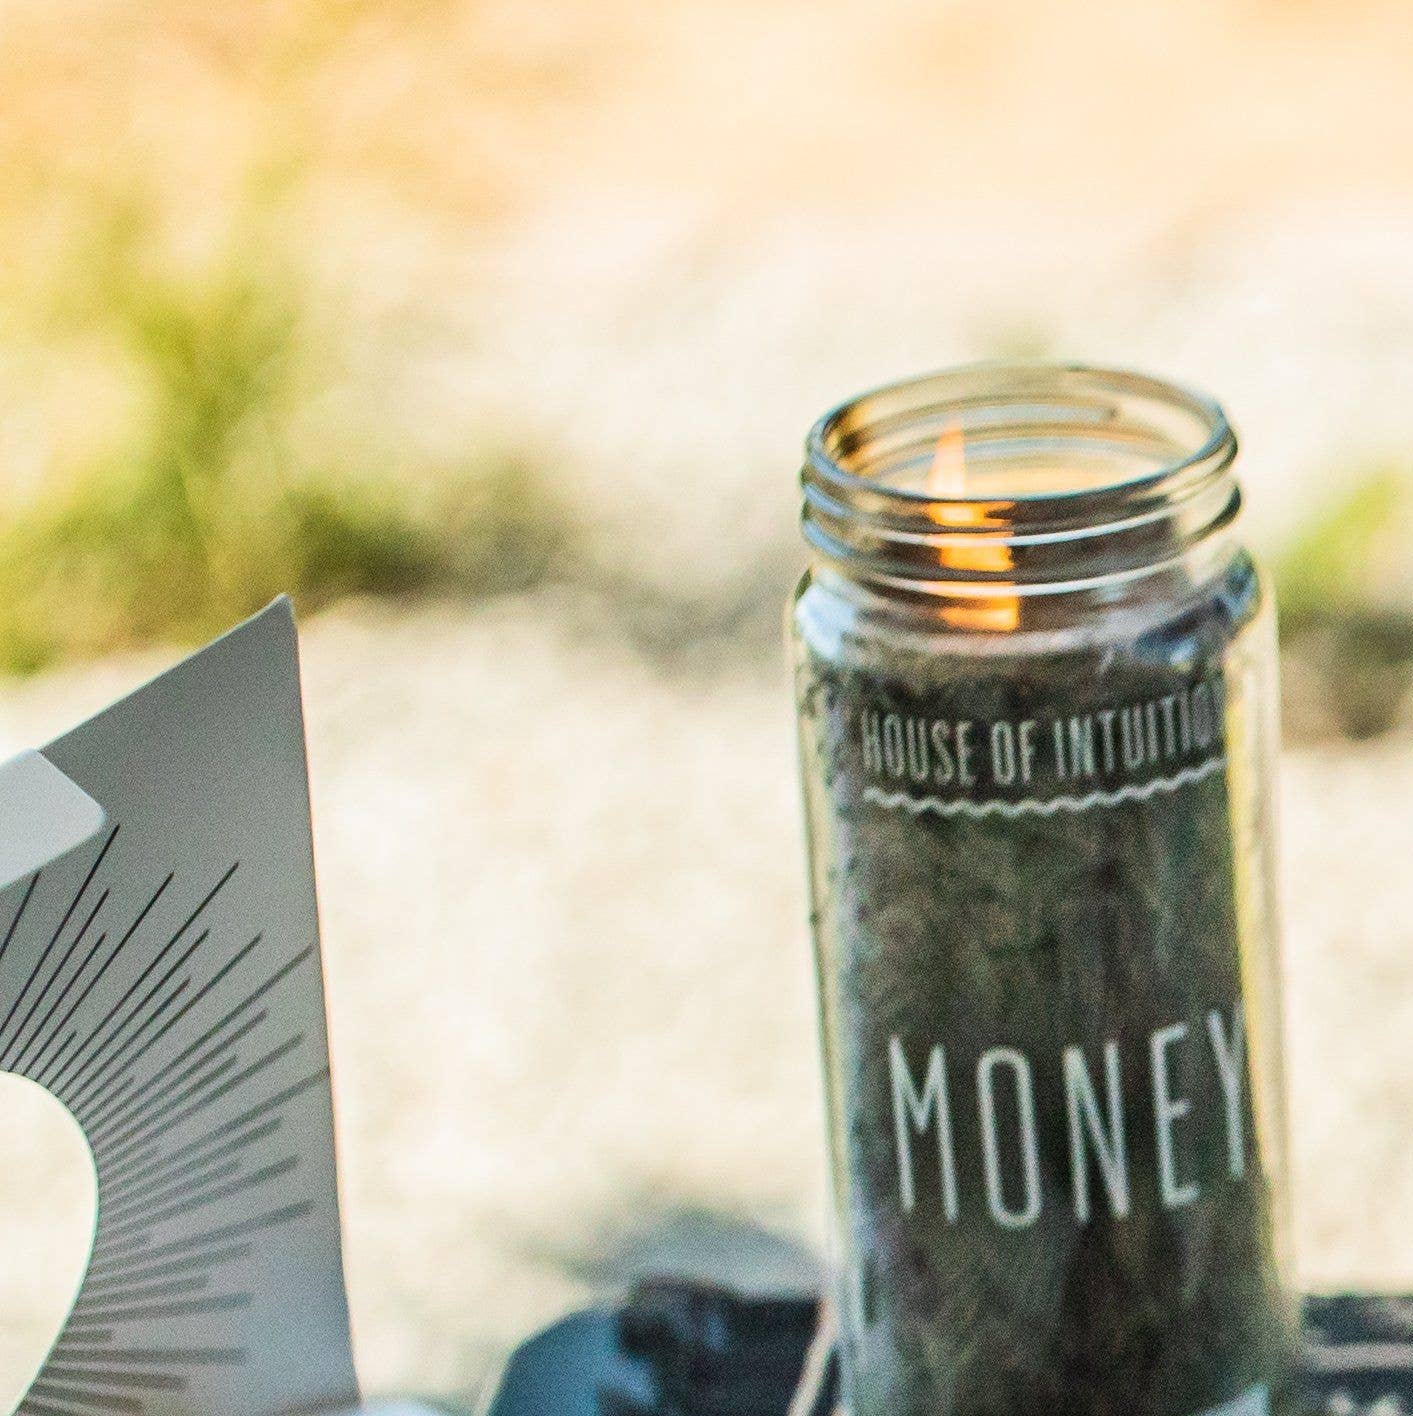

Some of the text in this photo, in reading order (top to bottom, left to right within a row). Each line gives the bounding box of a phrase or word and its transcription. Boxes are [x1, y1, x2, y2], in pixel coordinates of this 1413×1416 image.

[862, 709, 977, 788] HOUSE
[990, 719, 1038, 787] OF
[889, 1010, 1249, 1229] MONEY
